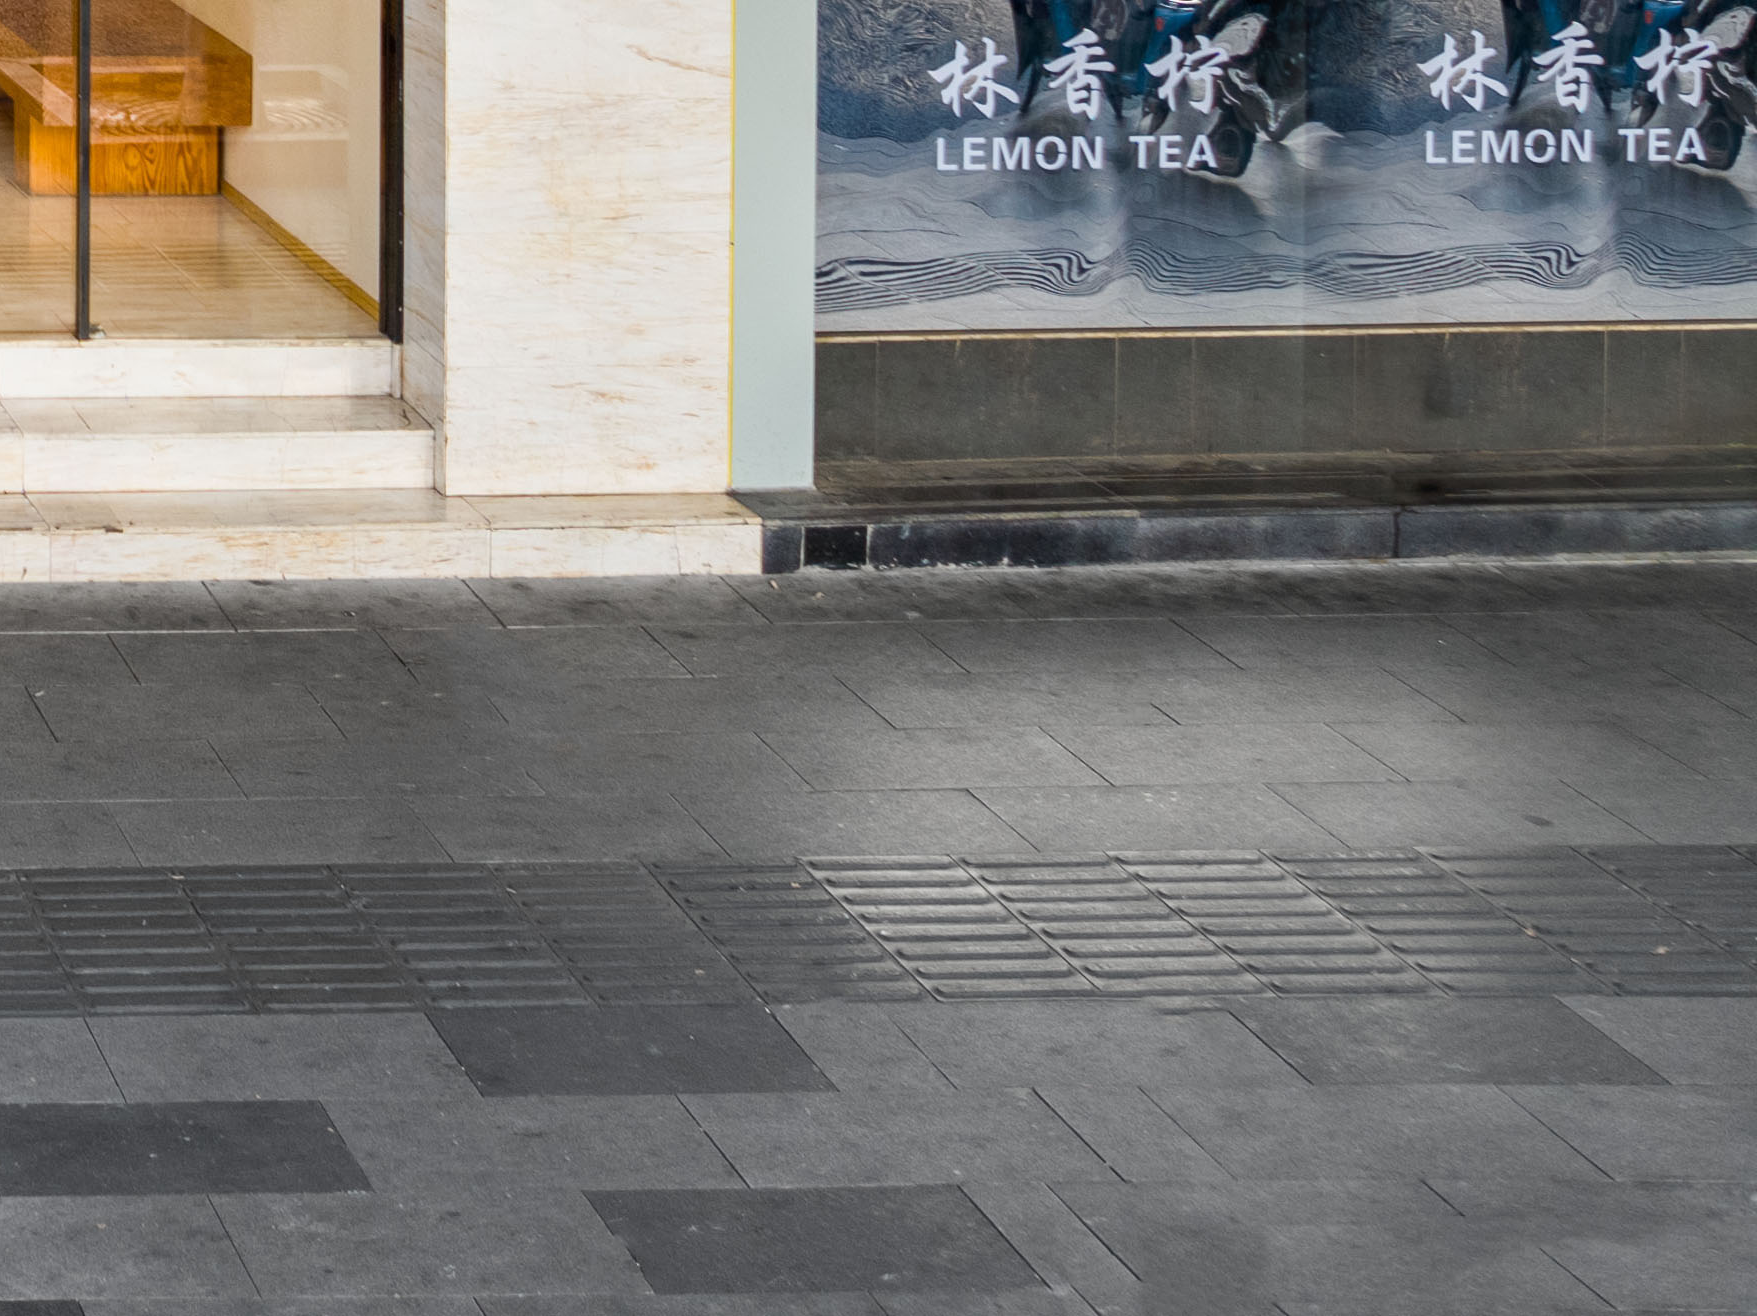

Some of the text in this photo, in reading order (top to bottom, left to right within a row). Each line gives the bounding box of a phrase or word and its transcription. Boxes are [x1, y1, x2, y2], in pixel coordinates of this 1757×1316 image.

[928, 28, 1231, 121] 林香柠
[1416, 21, 1721, 115] 林香柠
[936, 134, 1219, 172] LEMON TEA
[1425, 127, 1708, 165] LEMON TEA
